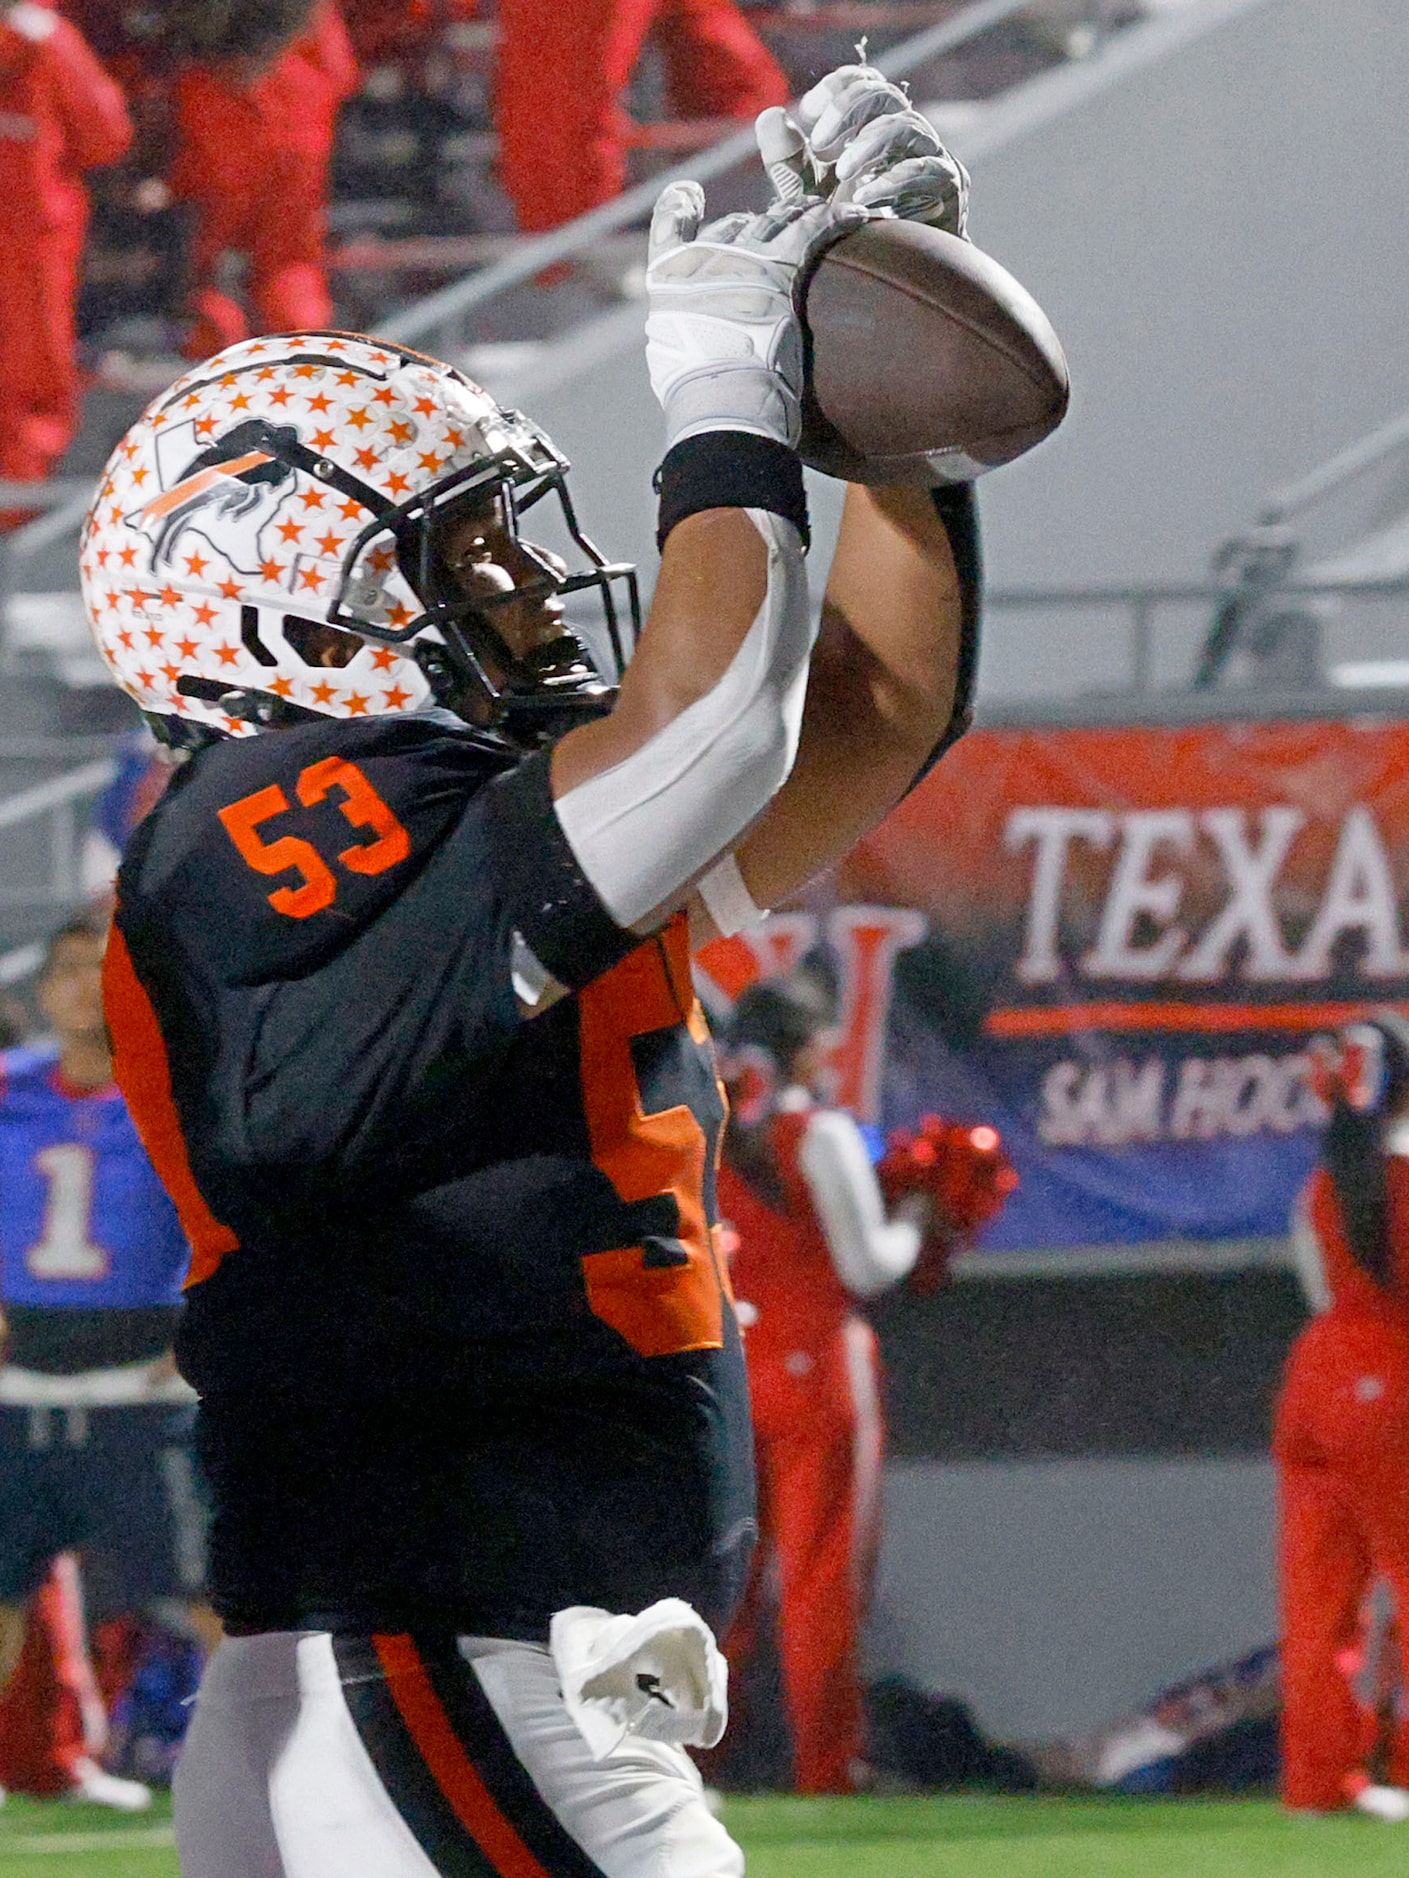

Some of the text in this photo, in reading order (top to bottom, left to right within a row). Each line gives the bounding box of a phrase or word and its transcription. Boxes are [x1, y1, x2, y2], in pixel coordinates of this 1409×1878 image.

[217, 755, 412, 920] 53
[1003, 803, 1409, 985] TEXA
[1041, 1058, 1166, 1147] SAM
[26, 1141, 113, 1281] 1
